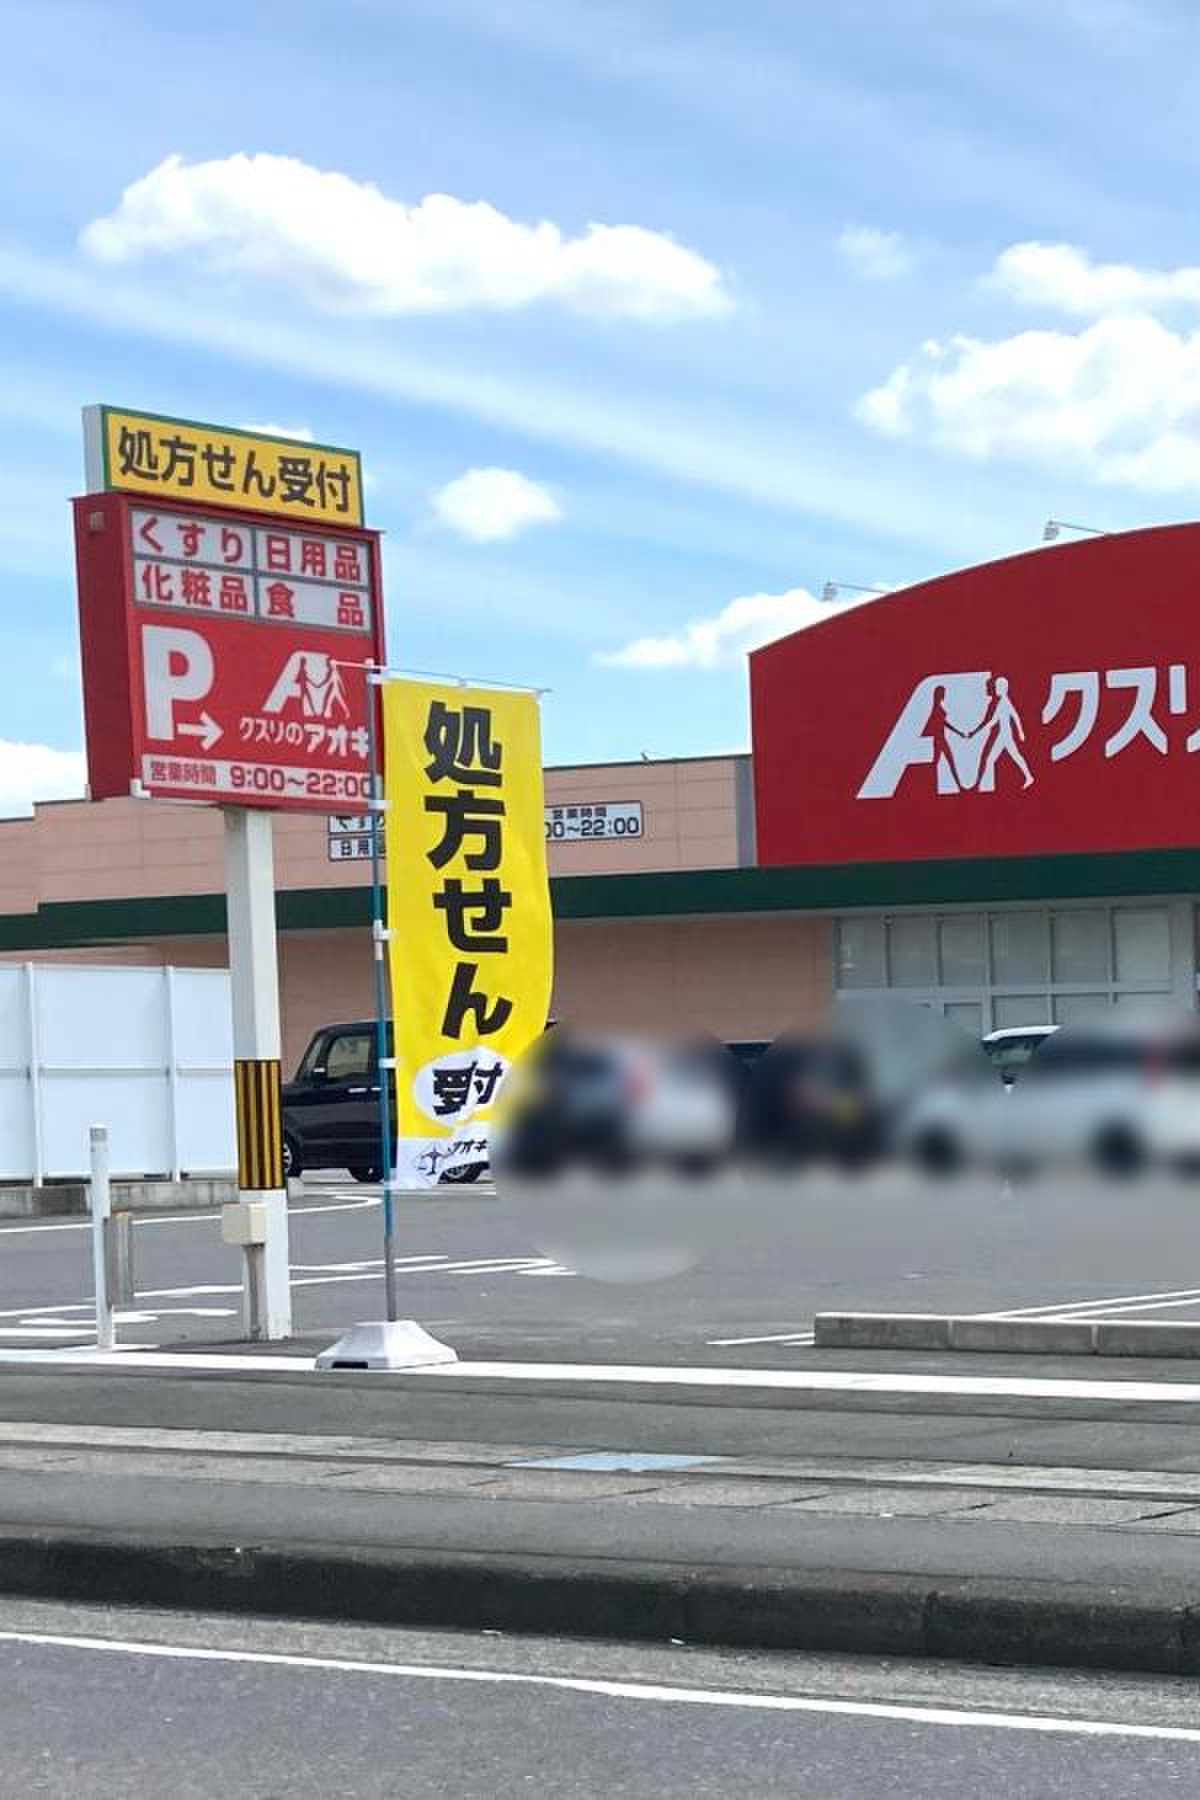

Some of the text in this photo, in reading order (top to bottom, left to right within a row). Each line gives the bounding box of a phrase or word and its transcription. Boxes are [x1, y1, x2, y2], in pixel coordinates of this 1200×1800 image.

[118, 426, 351, 512] 処方せん受付
[140, 516, 244, 563] くすり
[266, 534, 362, 582] 日用品
[142, 564, 249, 612] 化粧品
[142, 624, 214, 742] P
[239, 715, 370, 760] クスリのアオキ
[424, 700, 514, 1040] 処方せん
